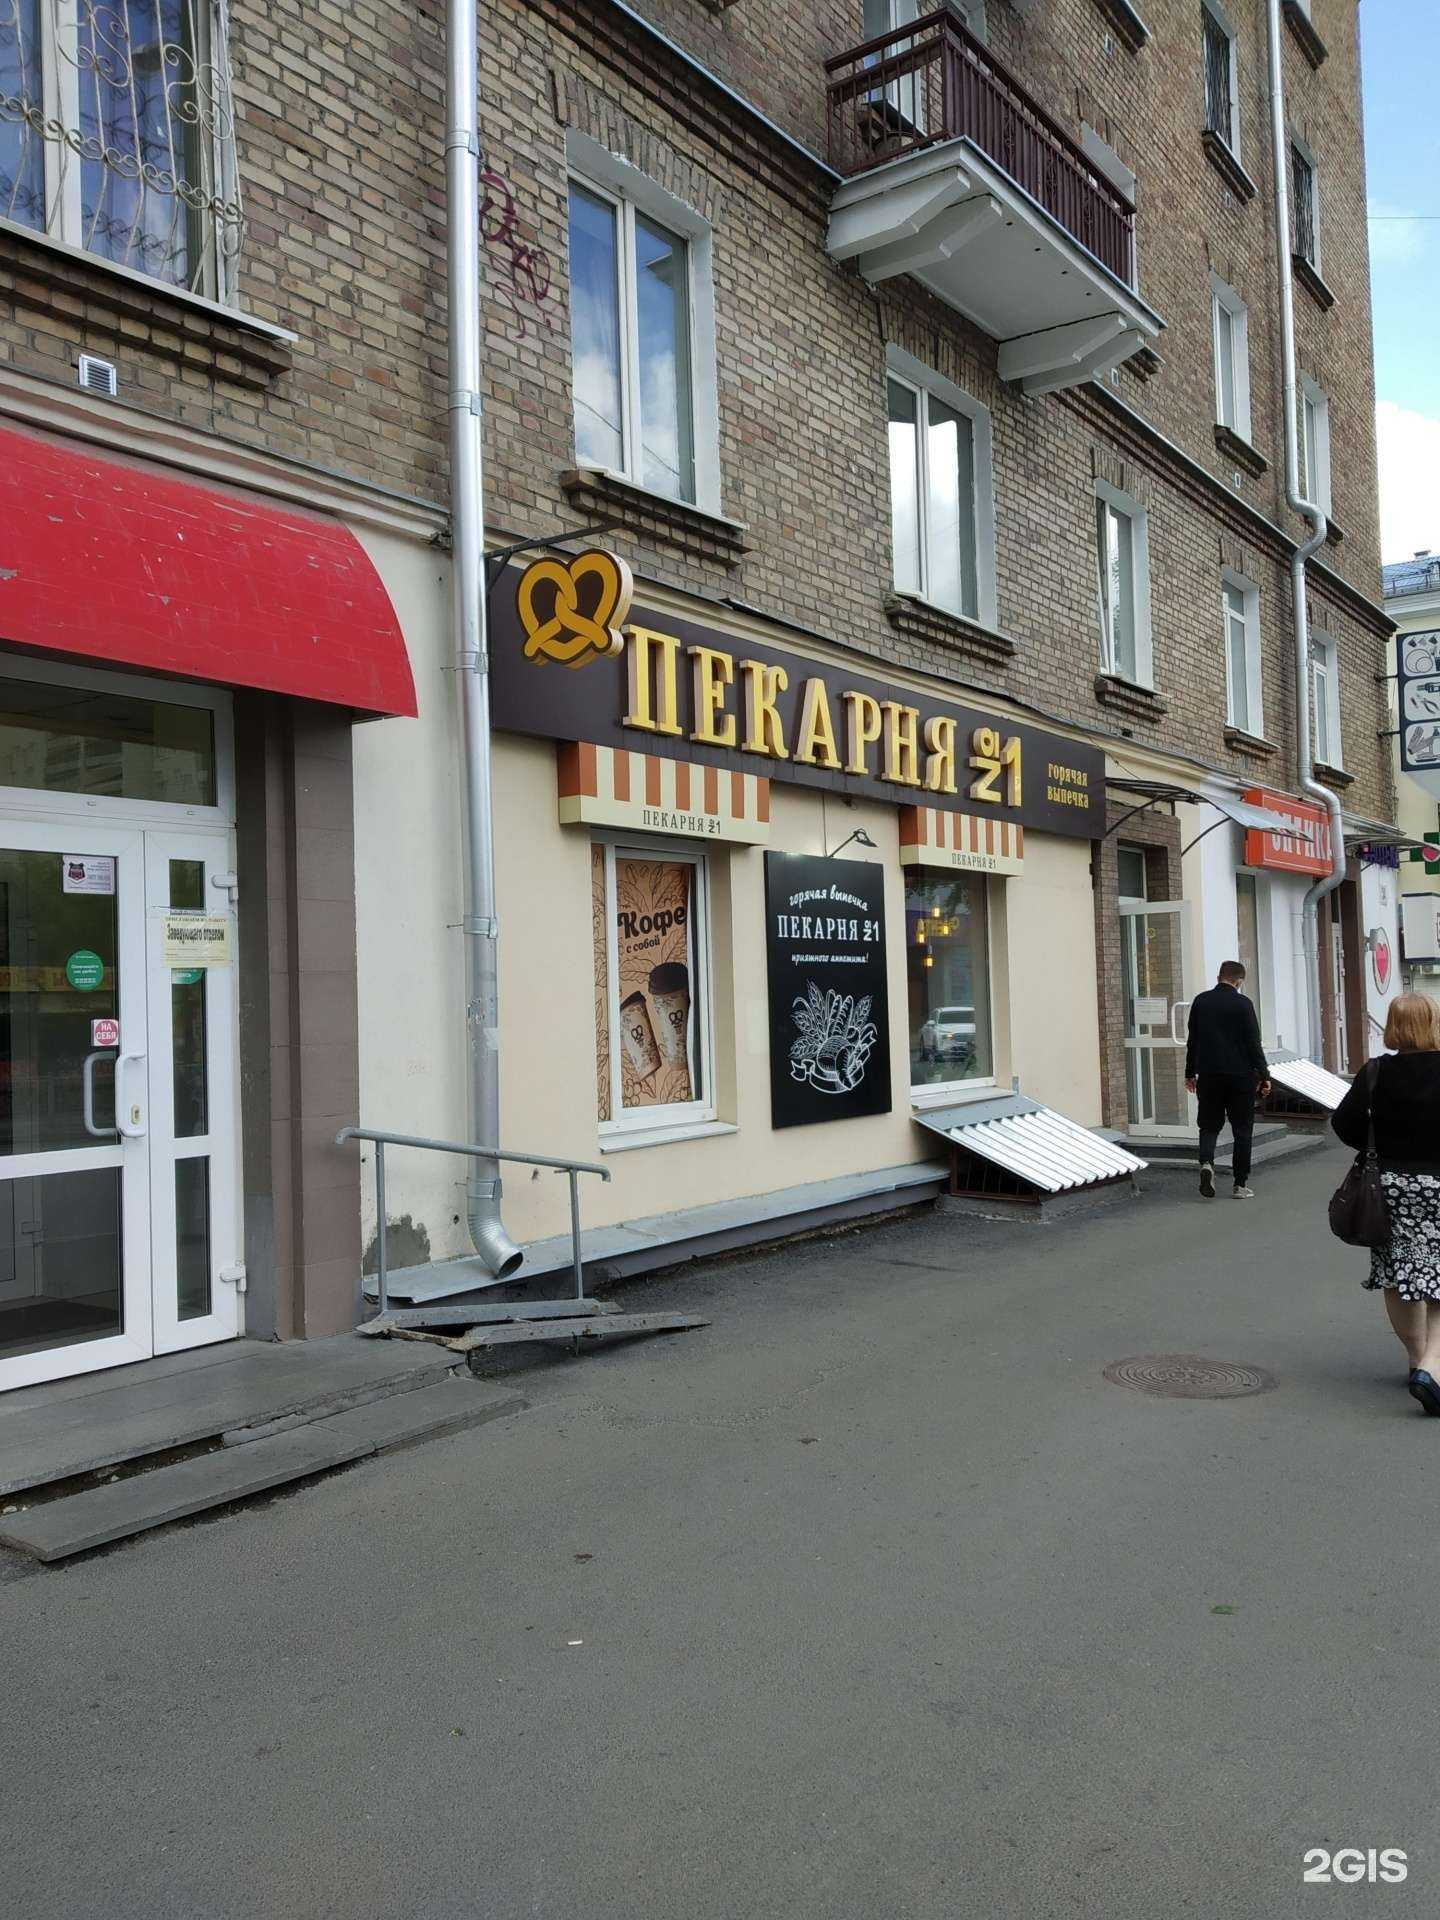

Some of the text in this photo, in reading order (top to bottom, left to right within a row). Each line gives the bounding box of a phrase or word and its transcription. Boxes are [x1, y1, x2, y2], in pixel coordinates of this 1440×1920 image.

[622, 624, 958, 794] ПЕКАРНЯ
[1048, 763, 1088, 787] горячая
[1047, 785, 1089, 808] выпечка
[643, 810, 704, 832] ПЕКАРНЯ
[952, 853, 987, 868] ПЕКАРНЯ
[789, 884, 868, 911] горячая выпечка
[617, 905, 687, 939] Кофе
[777, 915, 859, 940] ПЕКАРНЯ
[626, 934, 660, 954] с собой
[96, 1032, 116, 1040] СЕБЯ
[101, 1023, 112, 1031] НА
